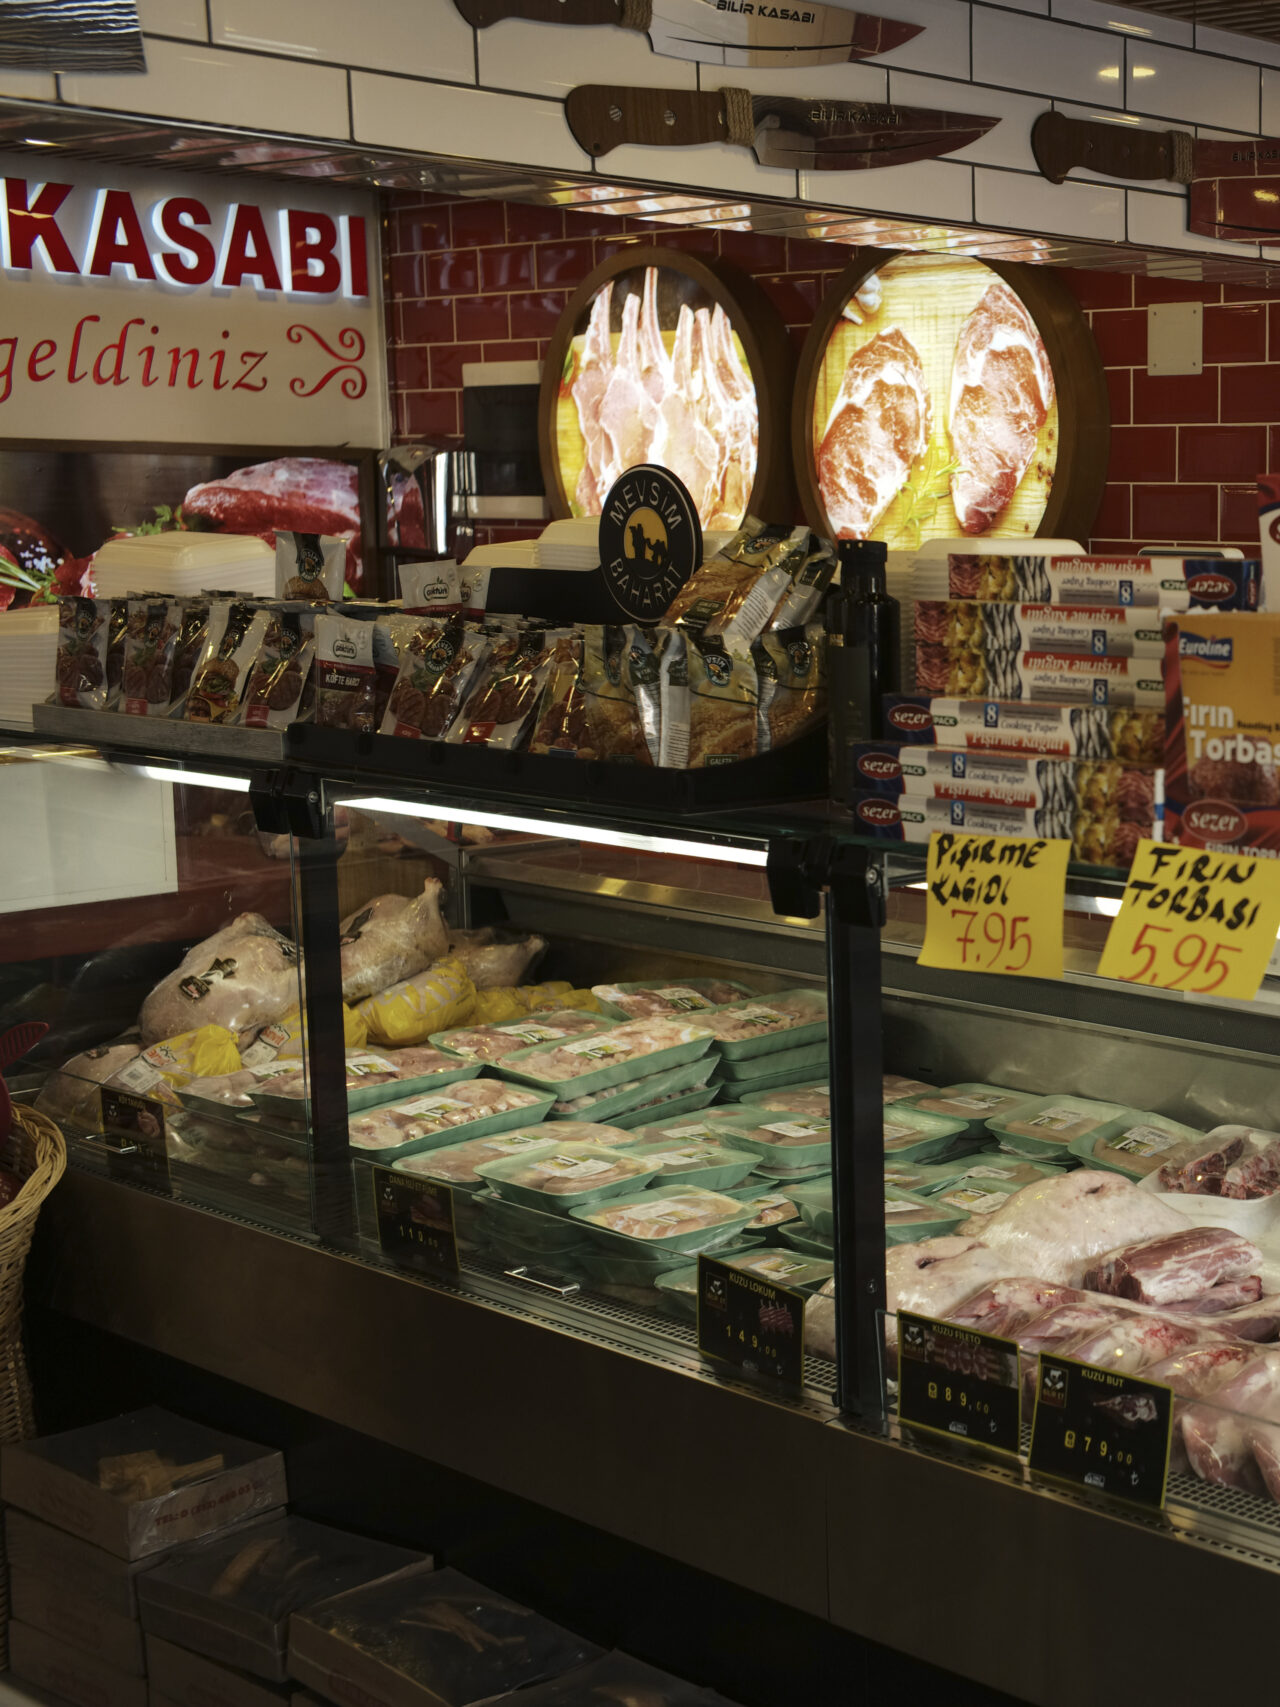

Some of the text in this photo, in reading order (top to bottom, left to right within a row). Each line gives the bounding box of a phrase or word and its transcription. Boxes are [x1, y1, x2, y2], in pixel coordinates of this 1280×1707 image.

[758, 5, 816, 24] KASABI
[849, 110, 900, 126] KASABI
[0, 176, 369, 298] KASABI
[0, 314, 268, 401] geldiniz
[609, 479, 684, 532] MEVSİM
[609, 556, 682, 608] BAHARAT
[1190, 575, 1231, 595] sezer
[1179, 636, 1232, 657] Euroline
[325, 674, 345, 686] KÖFTE
[892, 710, 956, 727] sezer PACK
[986, 704, 998, 722] 8
[1001, 718, 1060, 736] Cooking Paper
[862, 758, 925, 776] sezer PACK
[953, 754, 966, 772] 8
[967, 768, 1026, 786] Cooking Paper
[861, 804, 923, 823] sezer PACK
[952, 802, 965, 820] 8
[966, 815, 1024, 834] Cooking Paper
[1190, 811, 1240, 833] sezer
[1149, 846, 1257, 884] FIRIN
[1128, 880, 1262, 931] TORBASI
[729, 1271, 777, 1301] KUZU LOKUM
[931, 1324, 981, 1346] KUZU FİLETO
[1081, 1368, 1125, 1389] KUZU BUT
